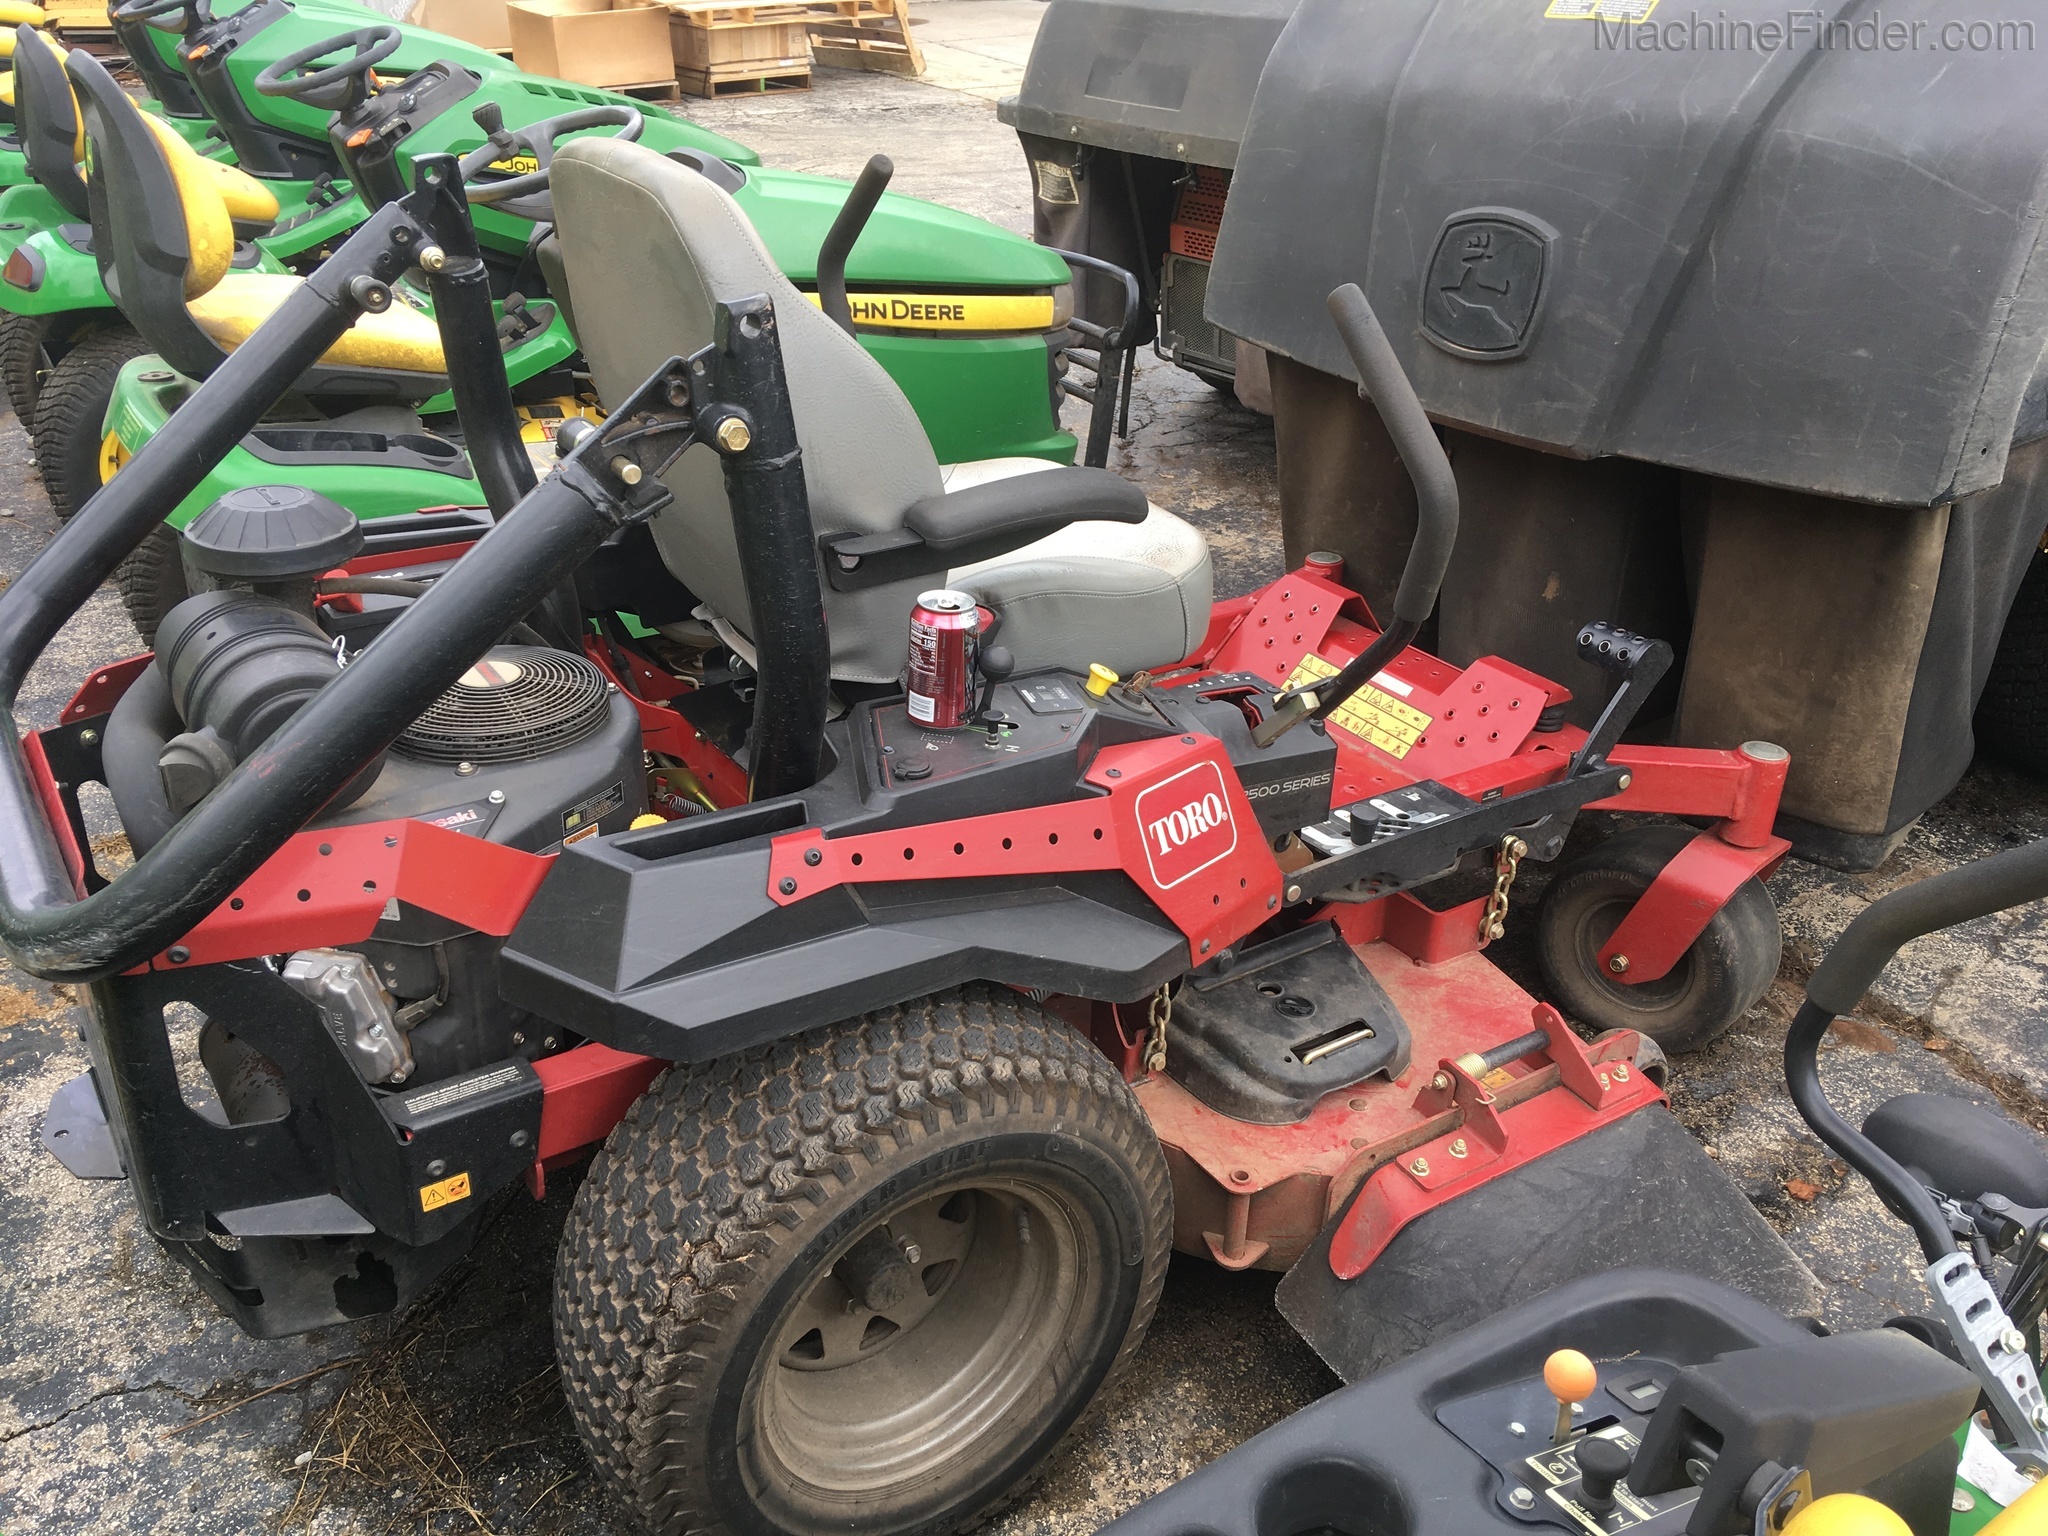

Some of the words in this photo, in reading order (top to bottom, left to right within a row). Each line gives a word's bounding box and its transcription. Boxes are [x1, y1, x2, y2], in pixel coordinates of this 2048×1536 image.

[505, 159, 537, 172] JOH
[851, 302, 887, 320] HN
[891, 300, 965, 321] DEERE
[1282, 773, 1331, 793] SERIES
[427, 809, 478, 828] saki
[1148, 792, 1223, 856] TORO
[802, 1179, 899, 1265] SUPER
[1530, 1460, 1557, 1482] Throttle
[1570, 1499, 1585, 1512] Pull
[1585, 1510, 1596, 1521] for
[1629, 1495, 1645, 1508] start
[1640, 1498, 1659, 1512] must
[1564, 1503, 1588, 1523] Choke
